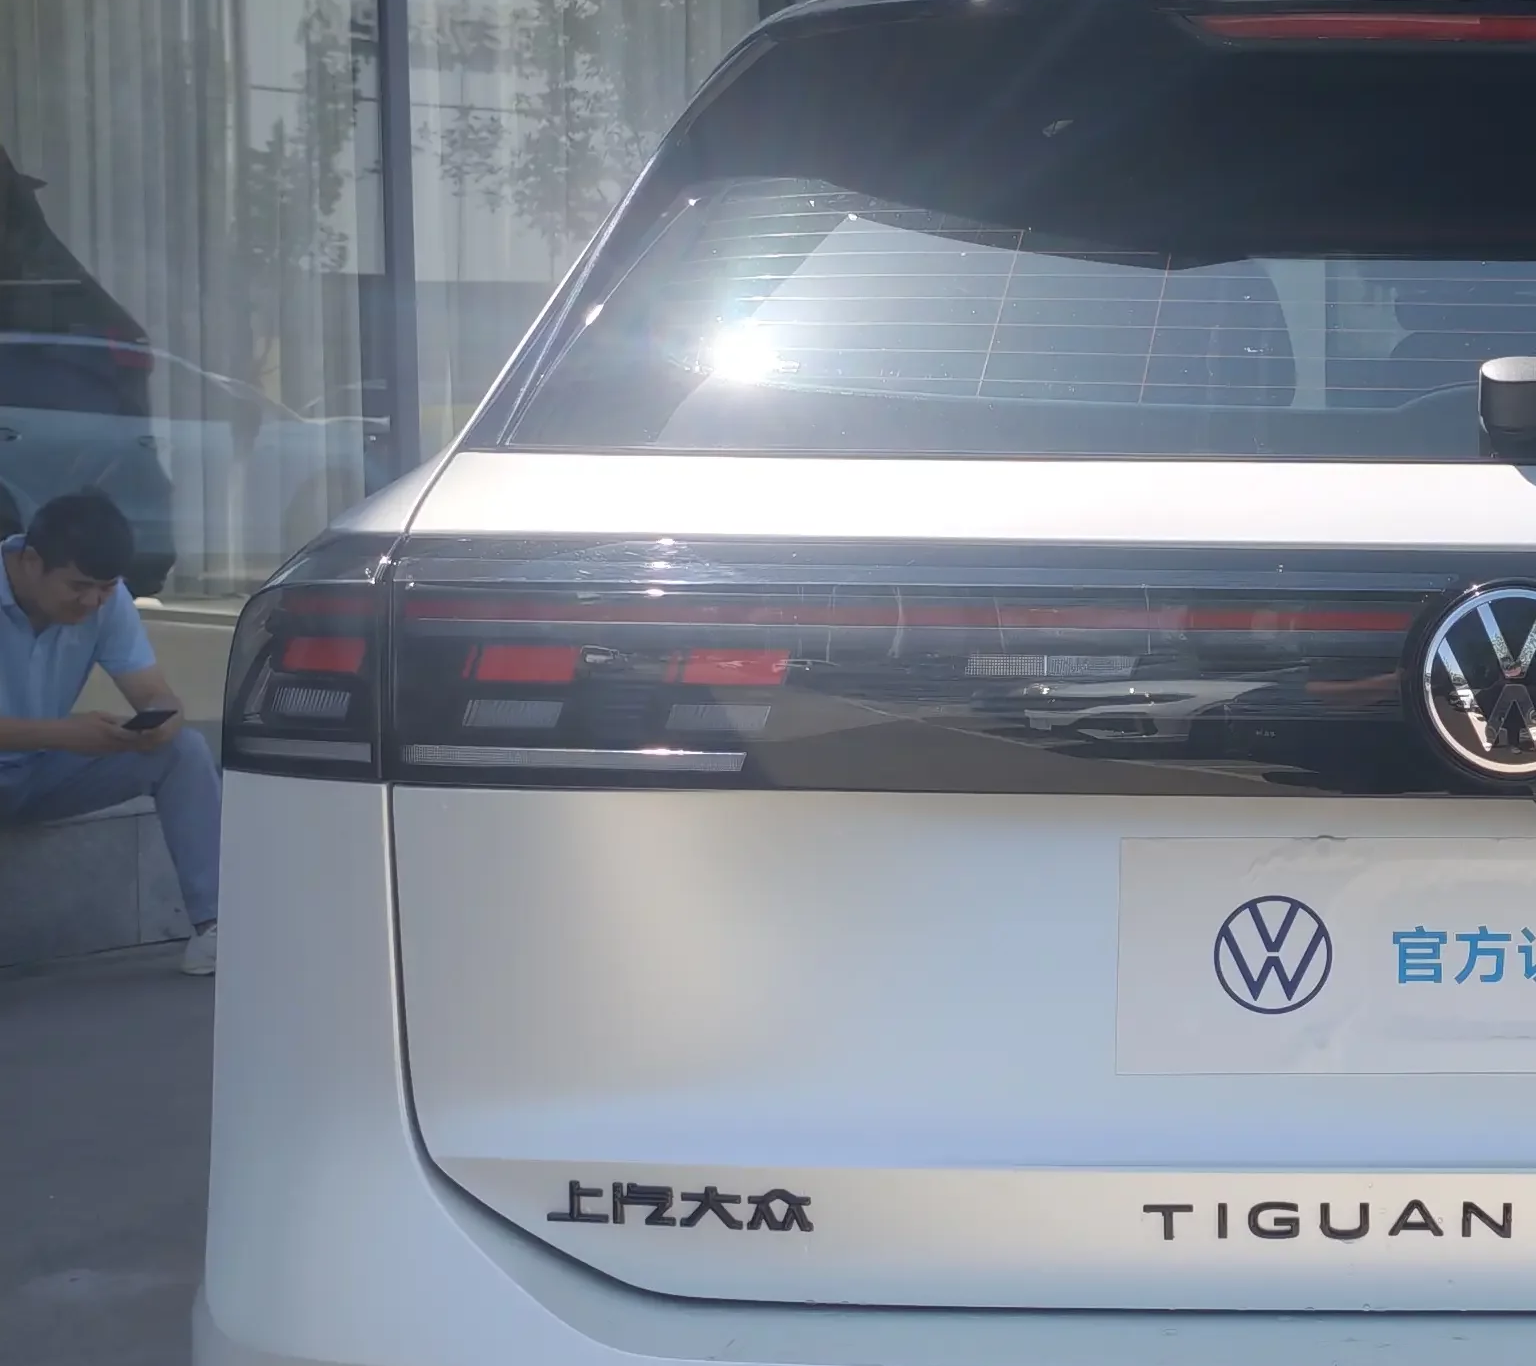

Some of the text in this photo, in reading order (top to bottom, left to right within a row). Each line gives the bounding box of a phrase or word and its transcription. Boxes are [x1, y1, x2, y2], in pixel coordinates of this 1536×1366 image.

[546, 1179, 814, 1232] 上汽大众
[1142, 1198, 1514, 1240] TIGUAN
